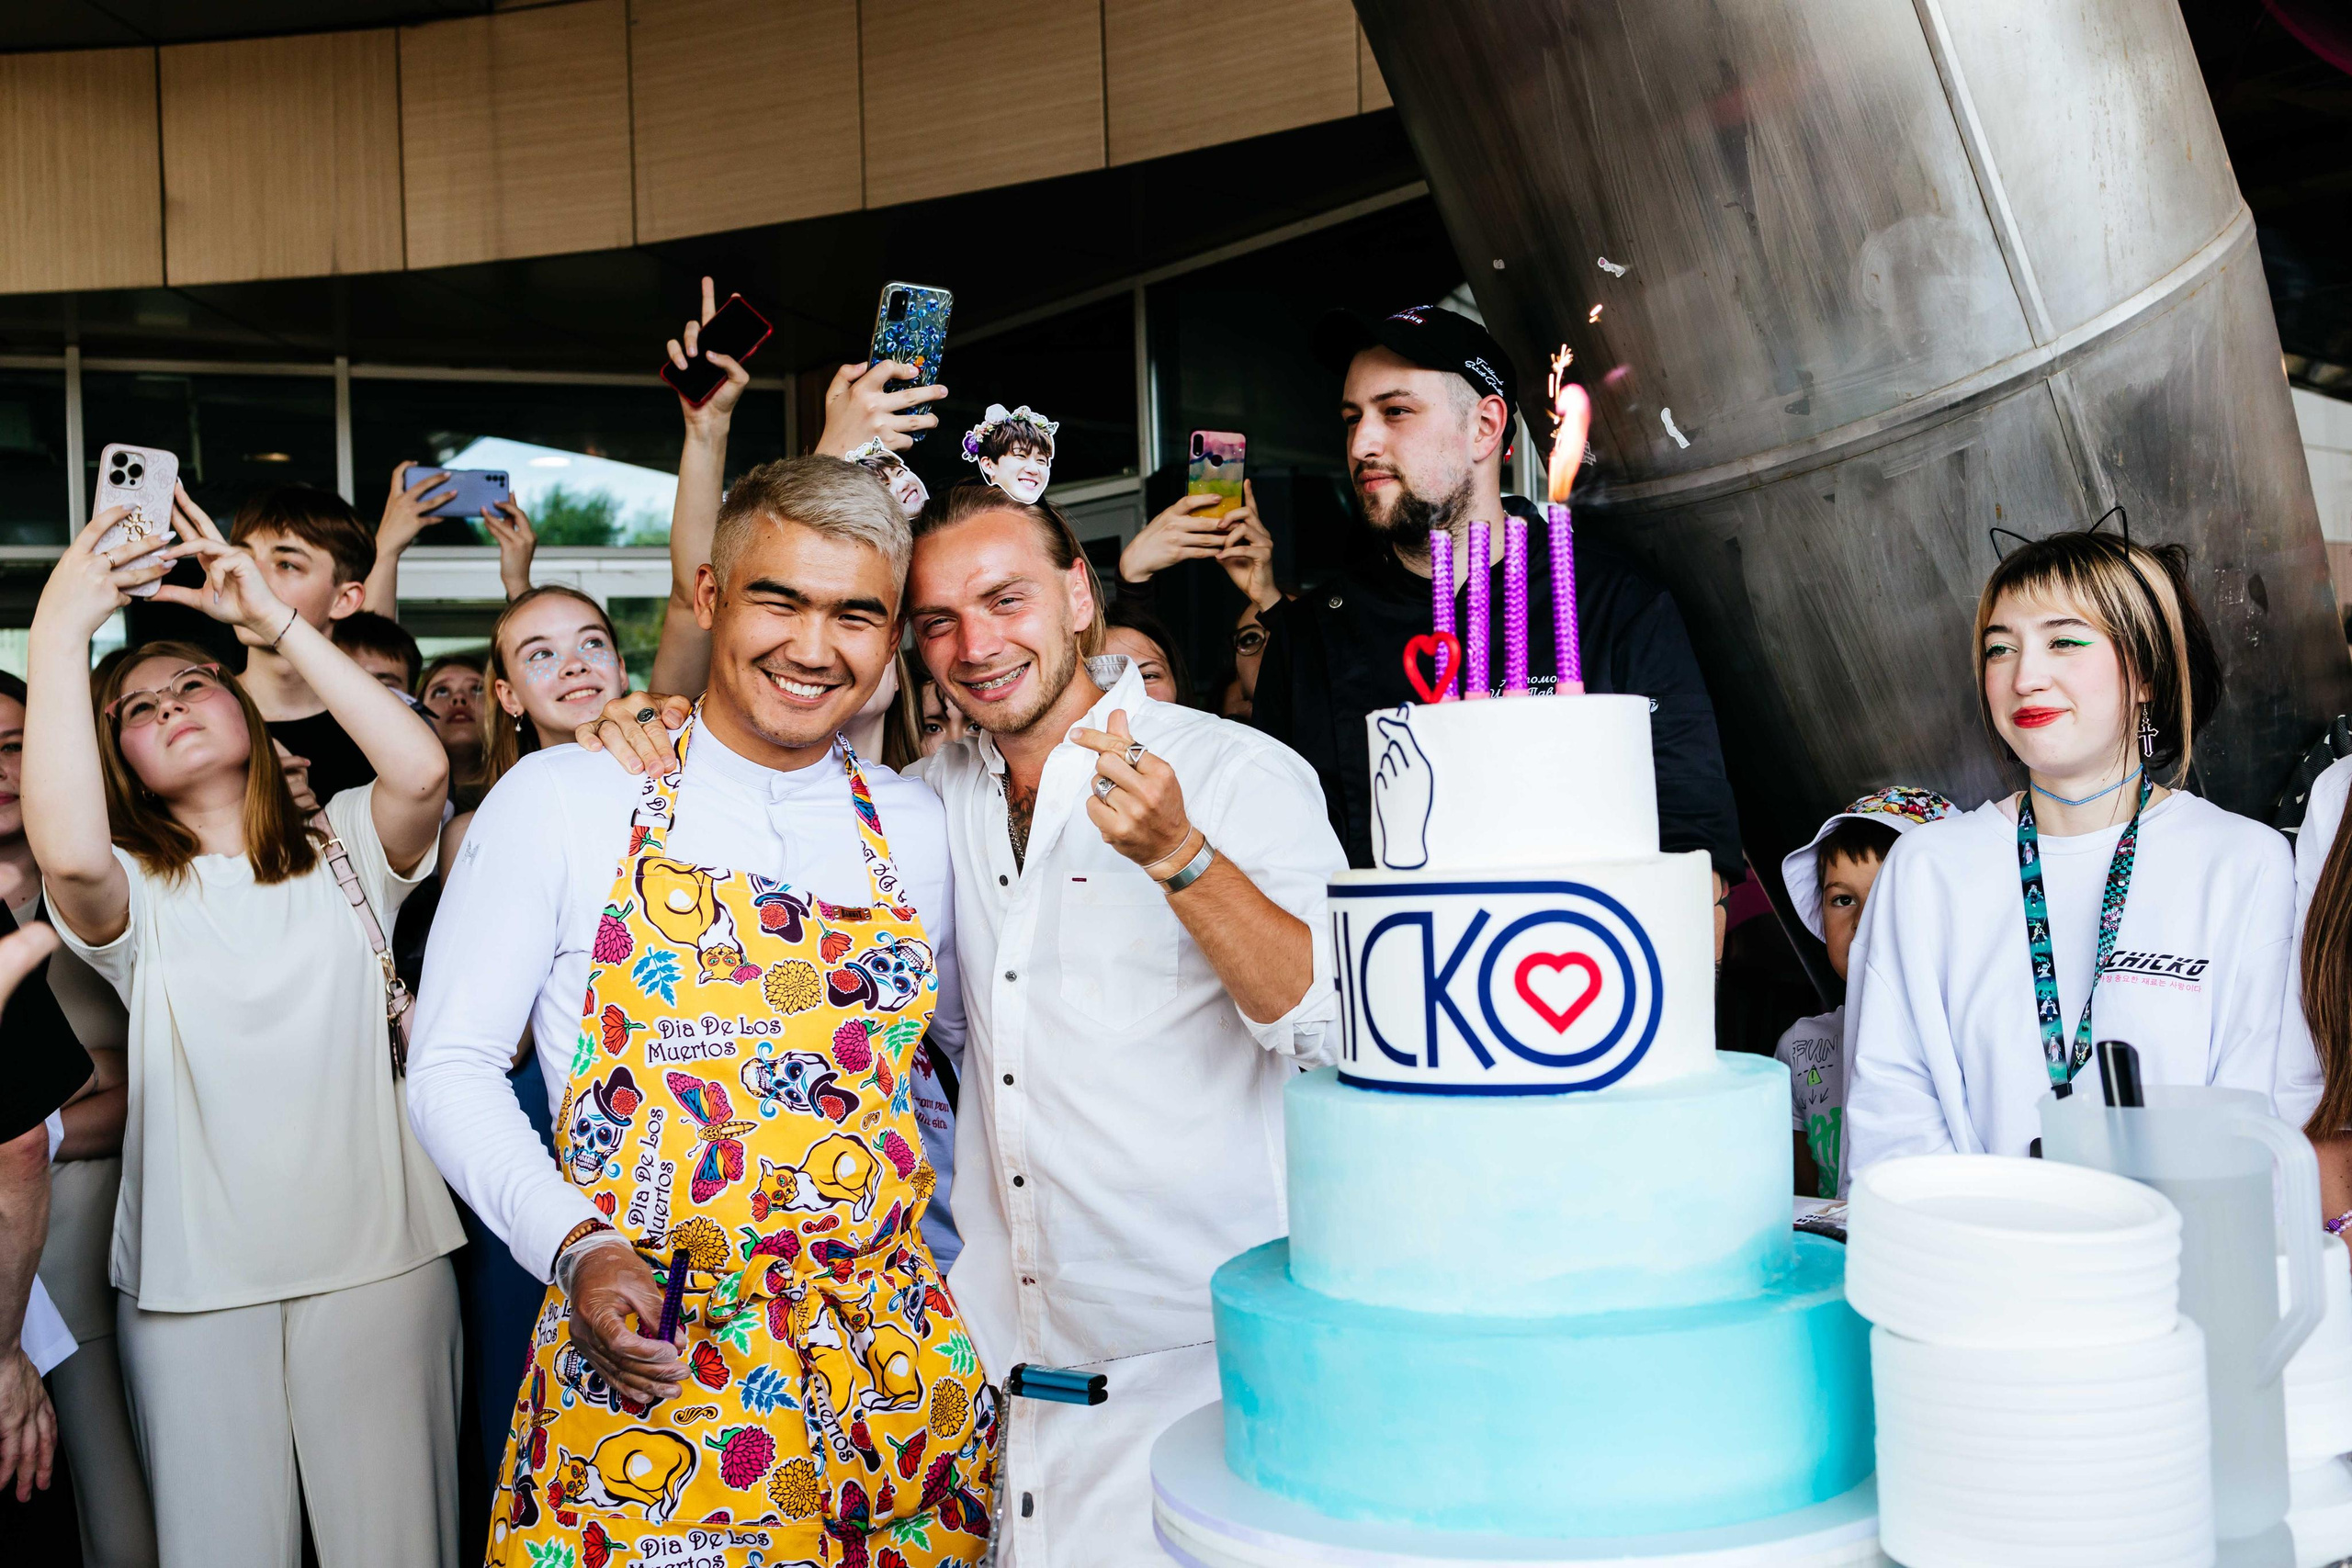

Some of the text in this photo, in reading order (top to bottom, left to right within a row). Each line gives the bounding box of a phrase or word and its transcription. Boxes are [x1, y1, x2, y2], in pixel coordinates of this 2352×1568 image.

[2105, 950, 2210, 976] CHICKO
[1333, 907, 1637, 1071] HICKO
[2114, 974, 2139, 984] 중요한
[2169, 980, 2202, 993] 사랑이다
[658, 1016, 782, 1040] Dia De Los
[648, 1040, 736, 1063] Muertos
[628, 1108, 664, 1225] Dia De Los
[640, 1529, 770, 1560] Dia De Los
